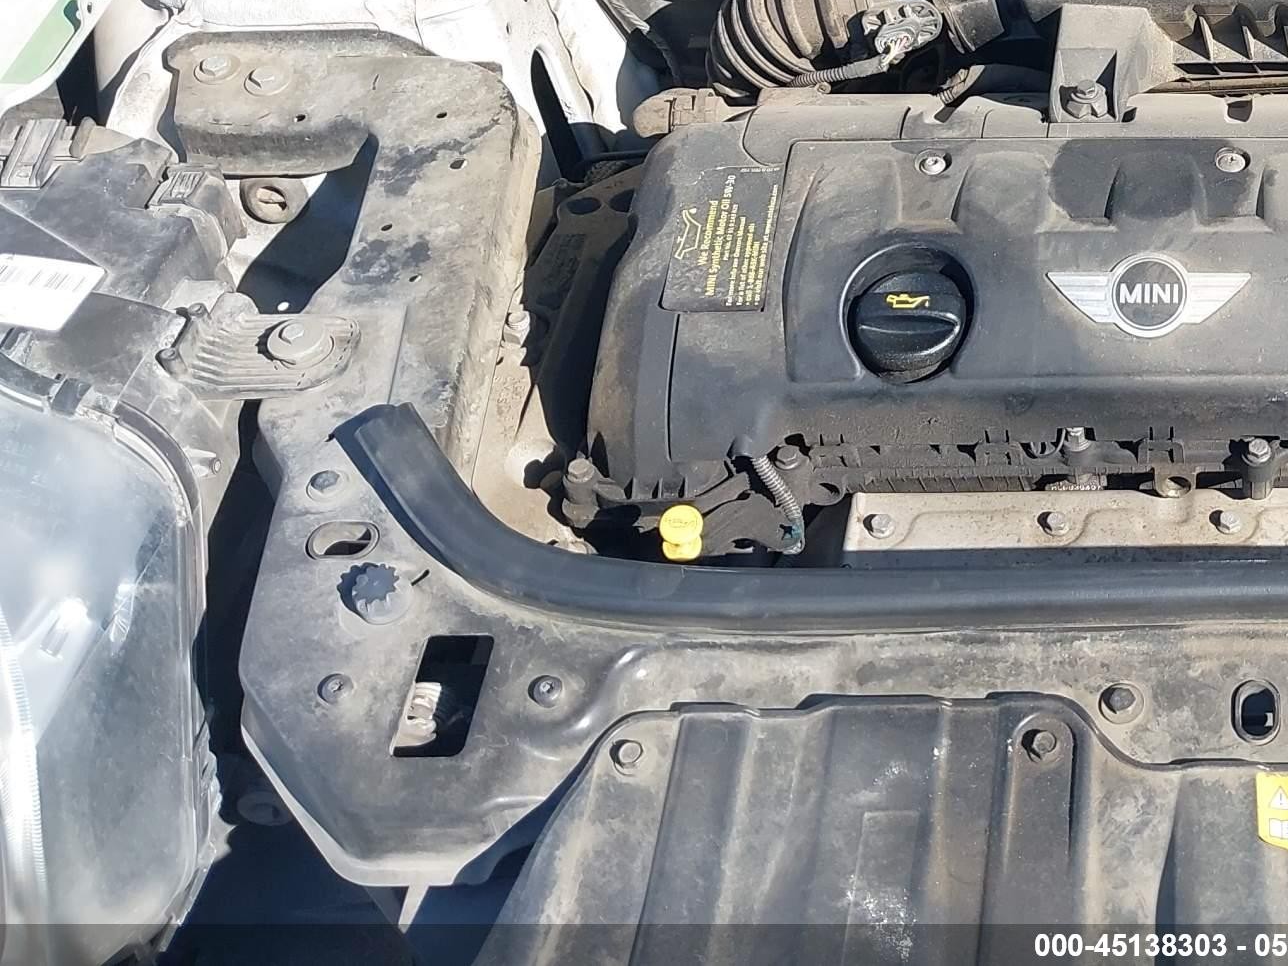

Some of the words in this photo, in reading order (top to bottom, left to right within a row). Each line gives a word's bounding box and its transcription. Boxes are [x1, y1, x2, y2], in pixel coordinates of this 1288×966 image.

[723, 175, 736, 197] 5W-30
[721, 199, 730, 209] Oil
[701, 200, 718, 250] Recommend
[716, 211, 728, 234] Motor
[697, 251, 708, 265] We
[709, 236, 723, 273] Synthetic
[728, 268, 737, 279] info
[736, 217, 746, 236] Manual
[760, 242, 768, 253] site
[705, 275, 717, 295] MINI
[1119, 283, 1179, 304] MINI
